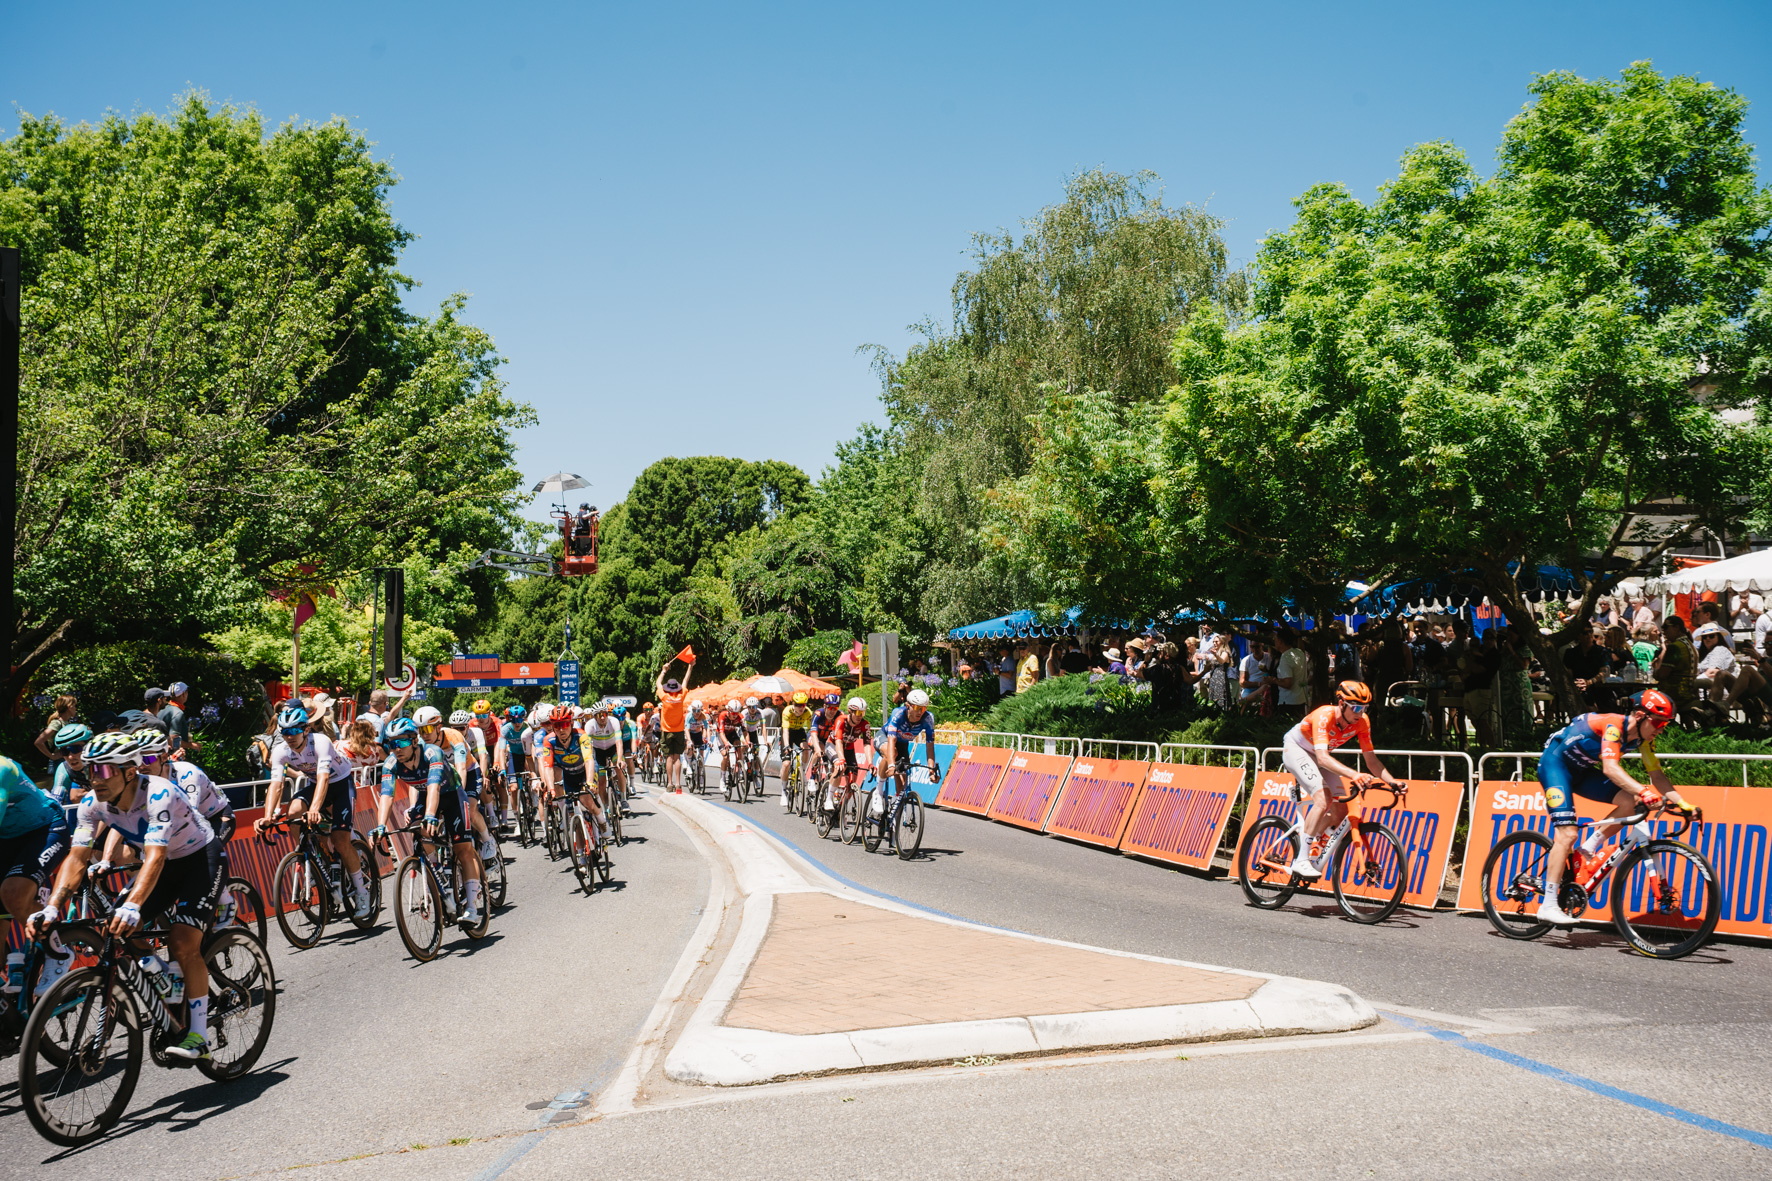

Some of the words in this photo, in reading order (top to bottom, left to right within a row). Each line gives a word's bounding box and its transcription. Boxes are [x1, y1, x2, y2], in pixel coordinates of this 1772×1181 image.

[1317, 715, 1329, 741] INEOS
[1074, 762, 1094, 775] Santos
[1150, 768, 1174, 784] Santos
[1296, 756, 1318, 781] INEOS
[1261, 779, 1308, 799] Sants
[1492, 789, 1547, 811] Sant
[37, 841, 64, 867] ASTANA
[1633, 938, 1657, 954] AEOLUS
[127, 959, 171, 1032] CANYON
[33, 1094, 101, 1138] ZIPP
